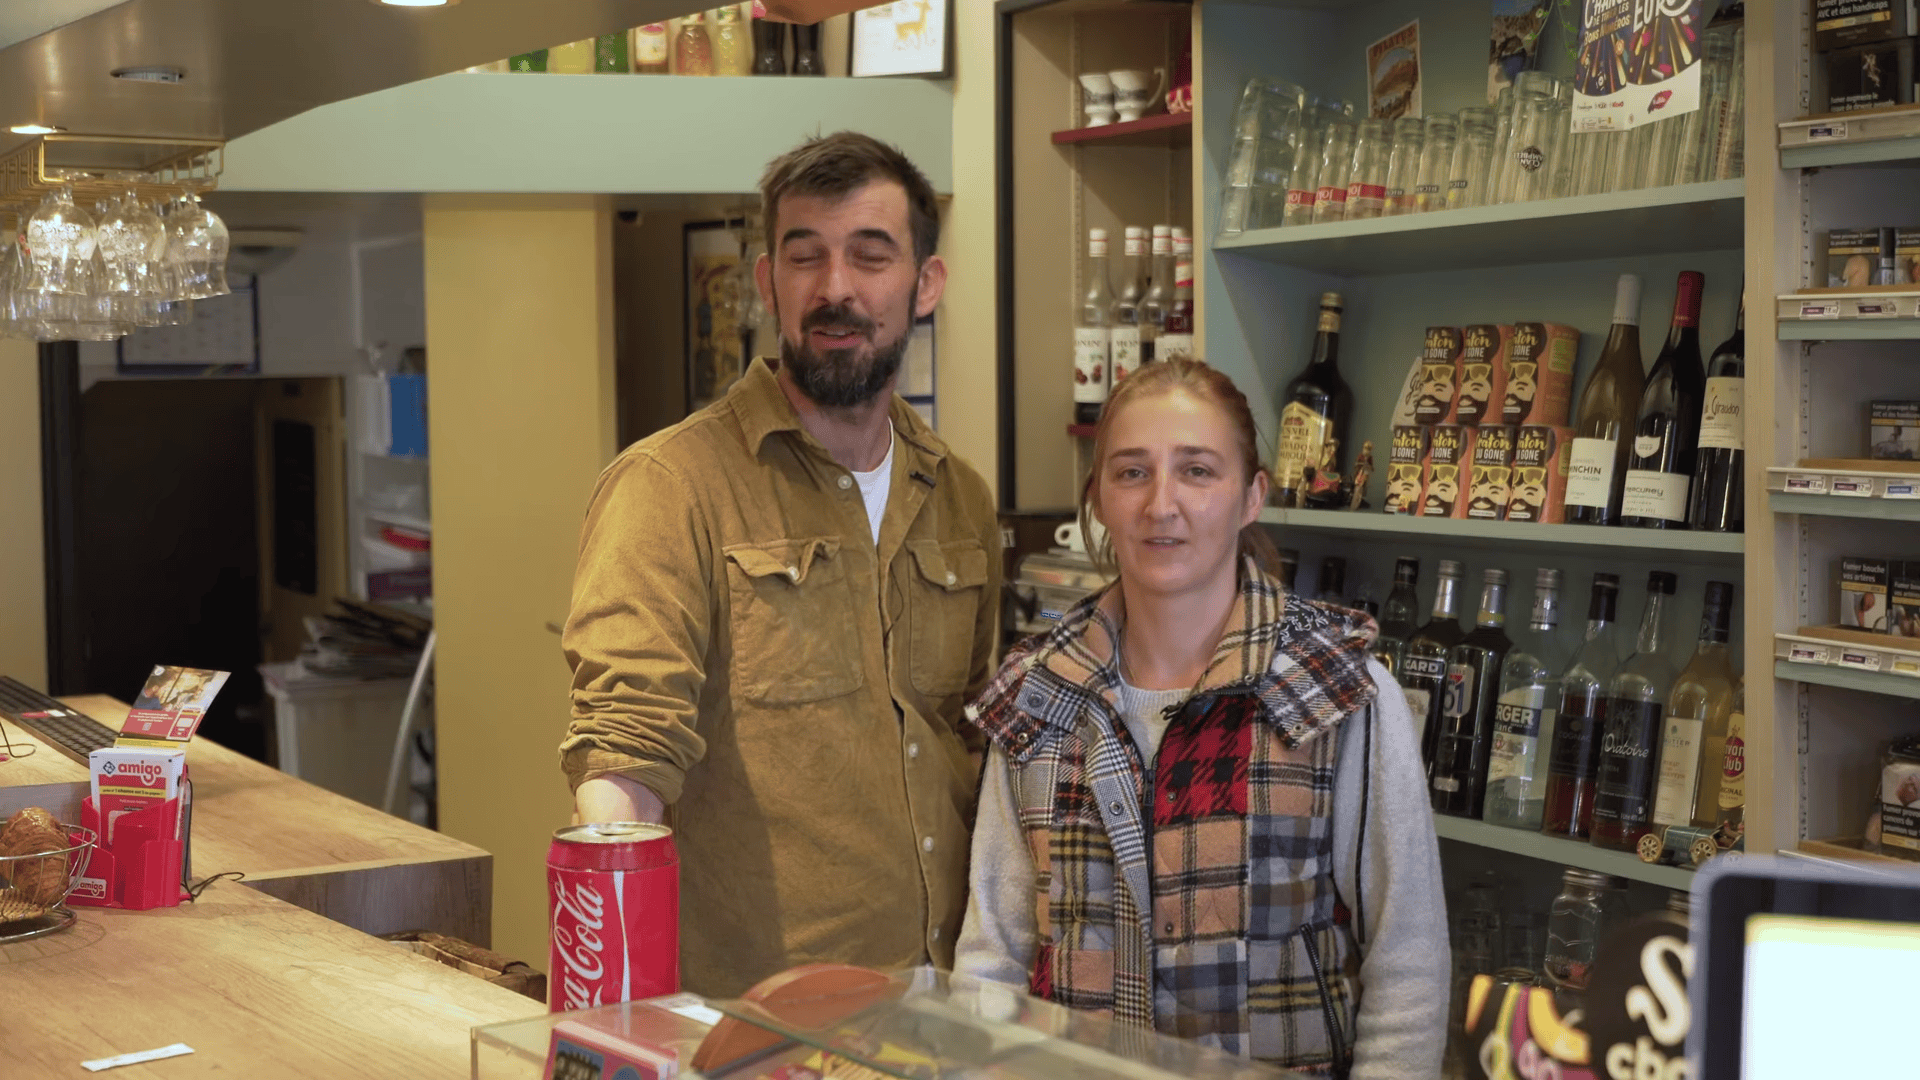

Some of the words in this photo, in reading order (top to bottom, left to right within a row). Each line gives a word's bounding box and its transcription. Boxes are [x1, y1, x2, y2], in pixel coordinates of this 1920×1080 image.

[1818, 9, 1830, 19] AVC
[1831, 9, 1838, 17] et
[1839, 5, 1851, 15] des
[1852, 1, 1889, 13] handicaps
[1484, 449, 1505, 461] GONE
[1569, 465, 1602, 475] INCHIN
[1842, 561, 1862, 572] Fumer
[1862, 564, 1886, 575] bouche
[1842, 572, 1853, 581] vos
[1405, 659, 1440, 674] CARD
[1496, 703, 1535, 728] RGER
[117, 759, 163, 784] amigo
[79, 880, 104, 895] amigo
